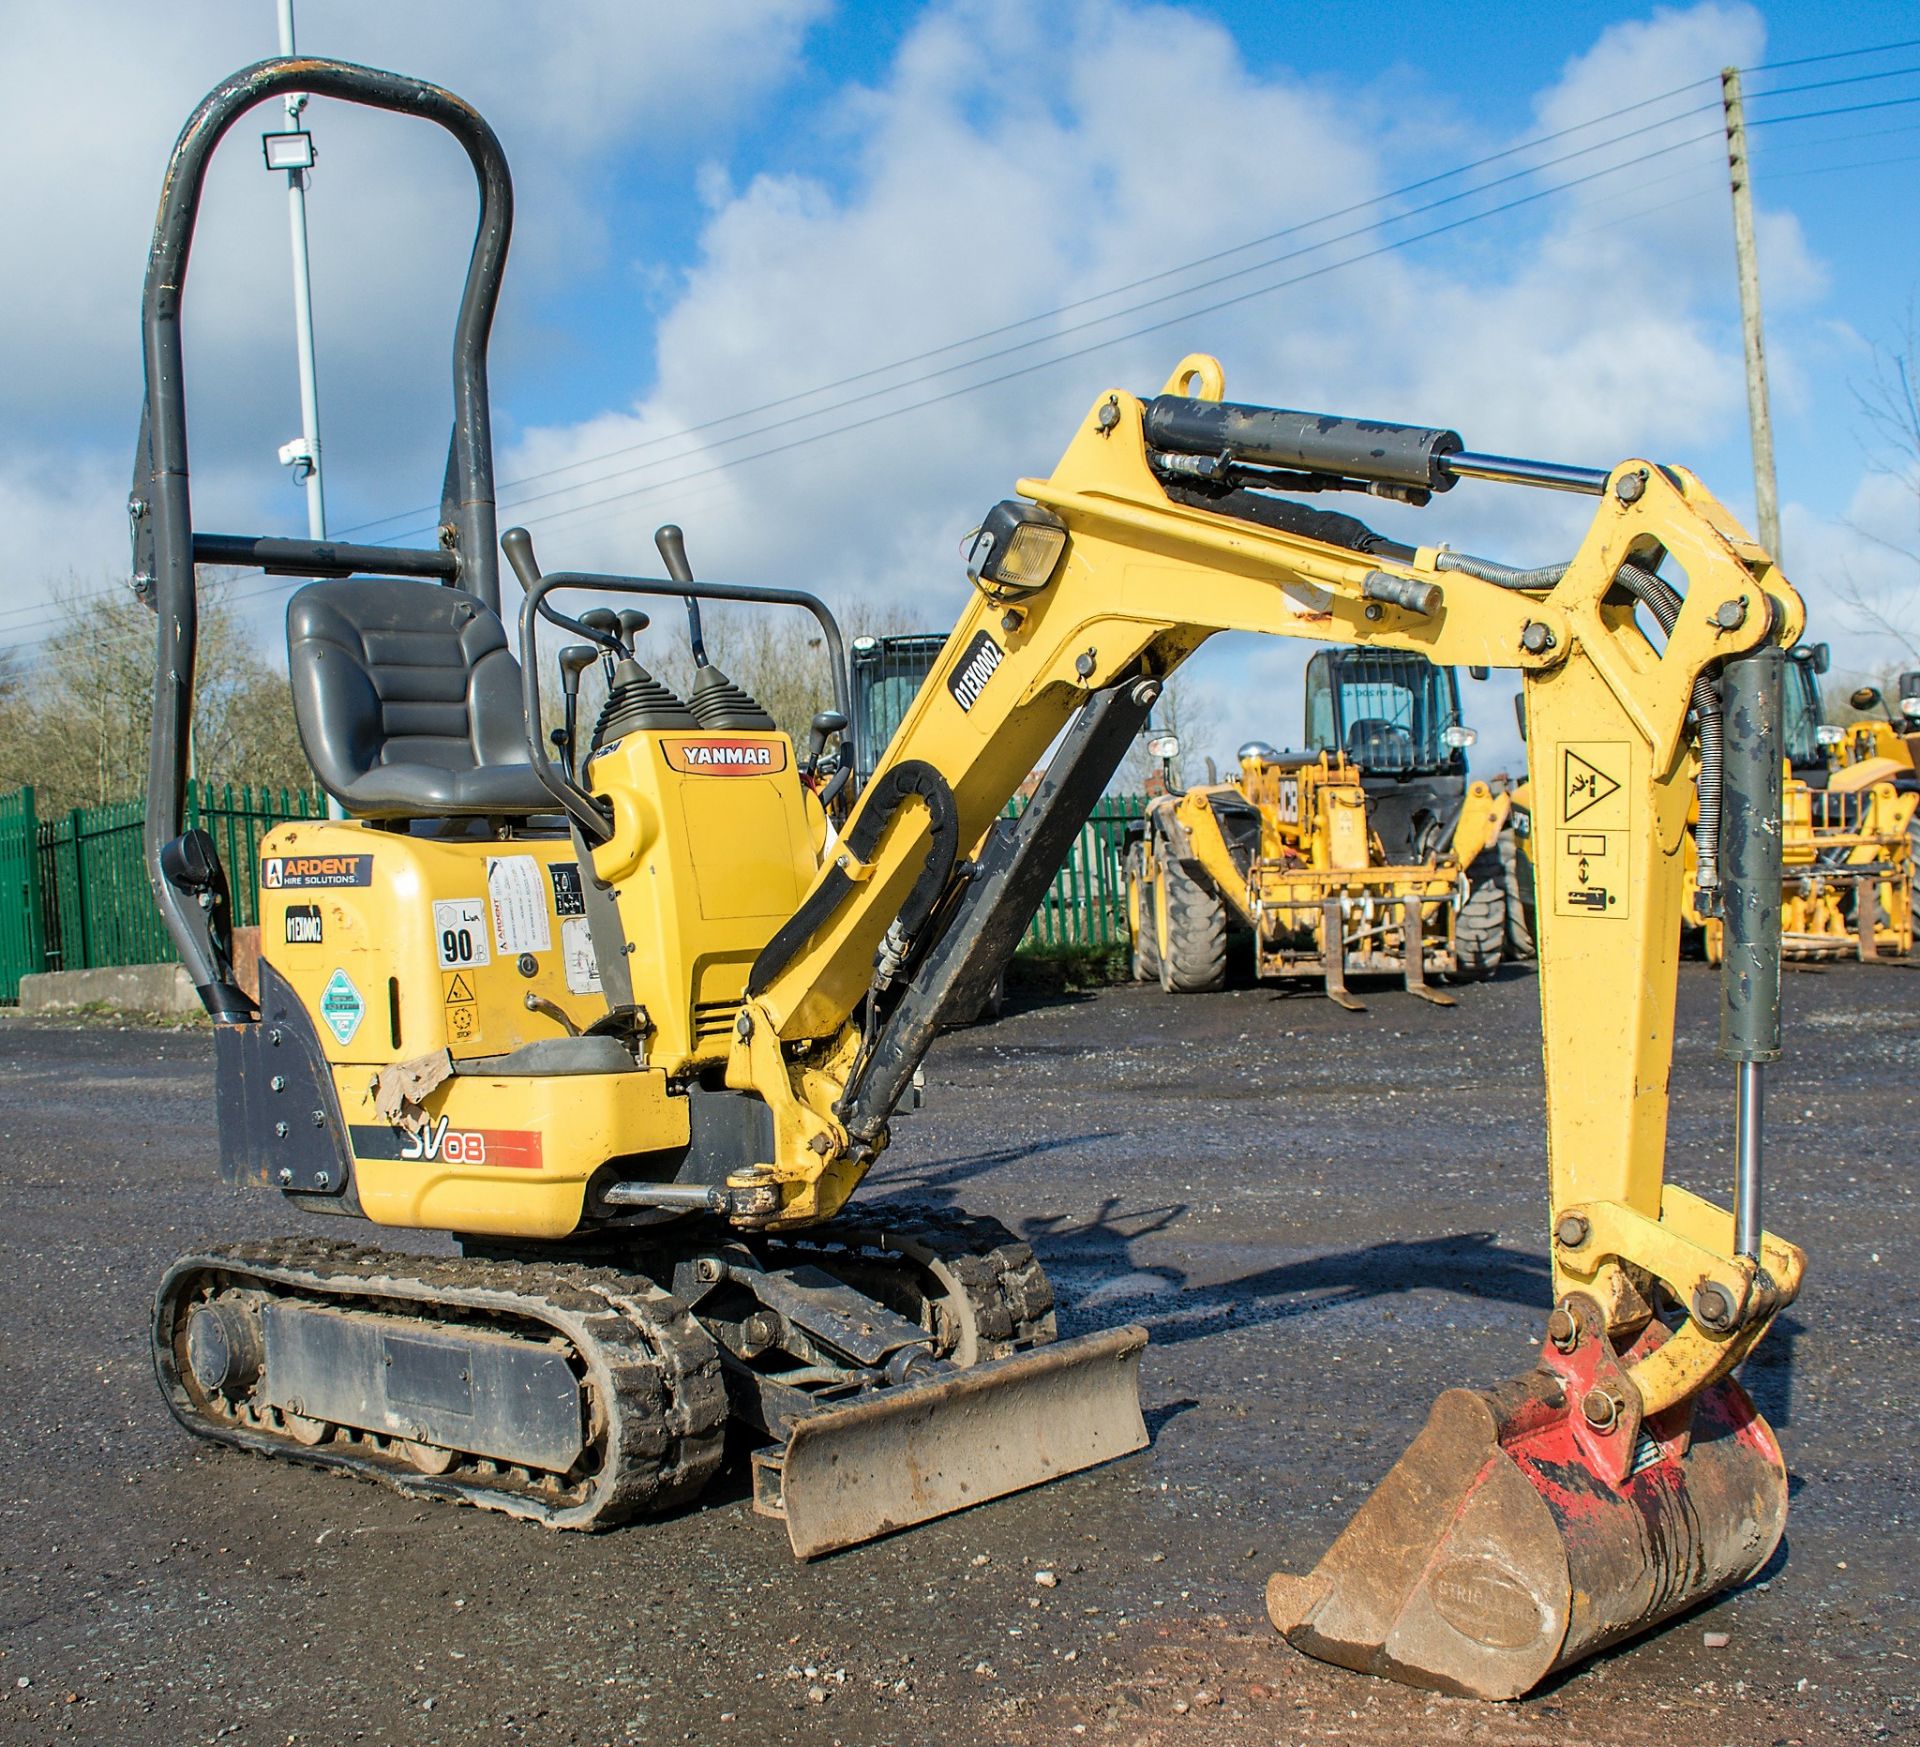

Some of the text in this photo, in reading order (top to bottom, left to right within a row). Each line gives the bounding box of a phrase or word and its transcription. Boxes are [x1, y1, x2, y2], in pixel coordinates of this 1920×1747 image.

[954, 639, 1003, 710] 01EX0002
[682, 747, 771, 765] YANMAR
[284, 857, 359, 876] ARDENT
[284, 877, 302, 885] HIRE
[493, 897, 505, 940] ARDENT
[443, 928, 472, 962] 90
